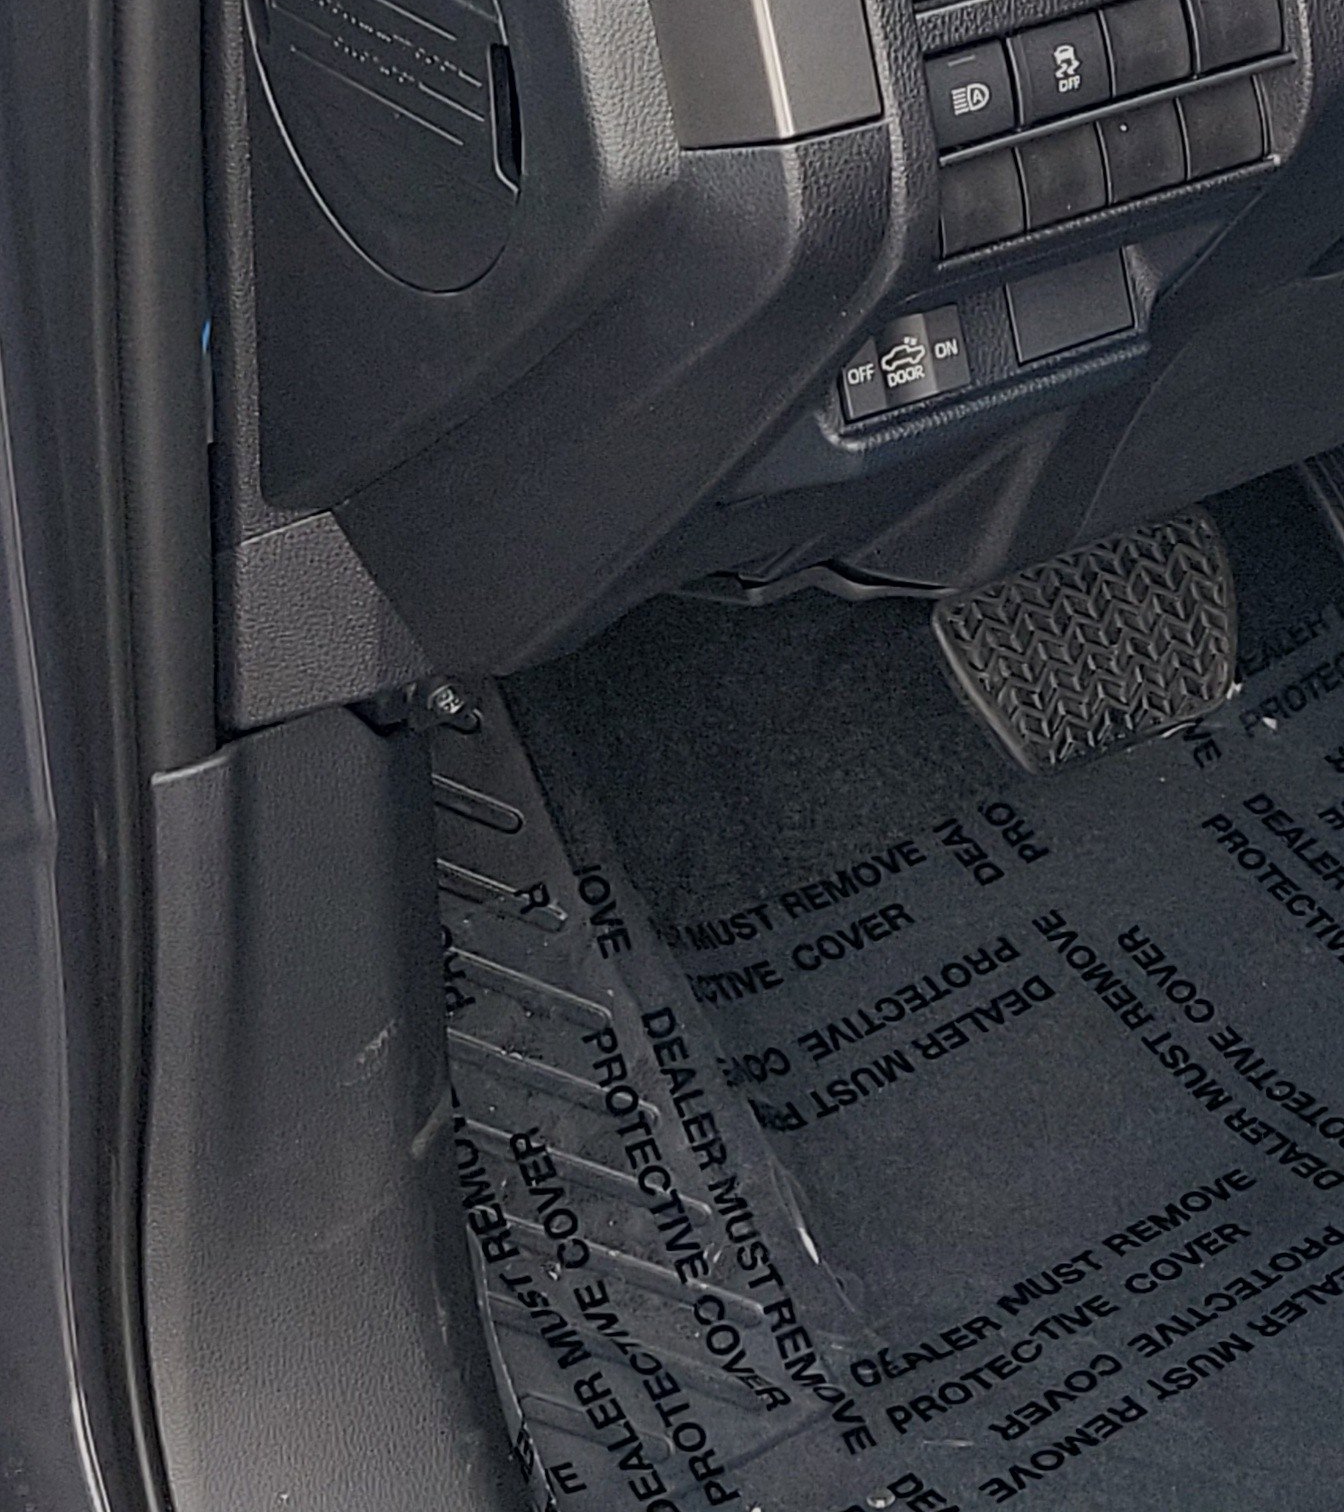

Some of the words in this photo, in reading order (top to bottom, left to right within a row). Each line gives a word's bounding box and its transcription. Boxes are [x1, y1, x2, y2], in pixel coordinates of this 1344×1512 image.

[1058, 75, 1081, 93] OFF
[848, 363, 875, 385] OFF
[887, 365, 925, 388] DOOR
[934, 338, 958, 359] ON
[781, 840, 927, 919] REMOVE
[791, 901, 915, 971] COVER
[1032, 909, 1154, 1031] REMOVE
[1117, 924, 1215, 1023] COVER
[798, 936, 1021, 1061] PROTECTIVE
[911, 975, 1055, 1060] DEALER
[810, 1050, 915, 1119] MUST
[1141, 1031, 1233, 1112] MUST
[510, 1126, 591, 1269] COVER
[581, 1027, 710, 1284] PROTECTIVE
[693, 1294, 792, 1412] COVER
[641, 1007, 727, 1171] DEALER
[708, 1175, 785, 1290] MUST
[764, 1296, 877, 1455] REMOVE
[997, 1250, 1103, 1316] MUST
[1102, 1168, 1259, 1258] REMOVE
[499, 1273, 592, 1370] MUST
[885, 1295, 1121, 1435] PROTECTIVE
[1124, 1222, 1253, 1295] COVER
[1145, 1332, 1255, 1402] MUST
[574, 1280, 742, 1506] PROTECTIVE
[988, 1353, 1123, 1442] COVER
[977, 1395, 1148, 1504] REMOVE
